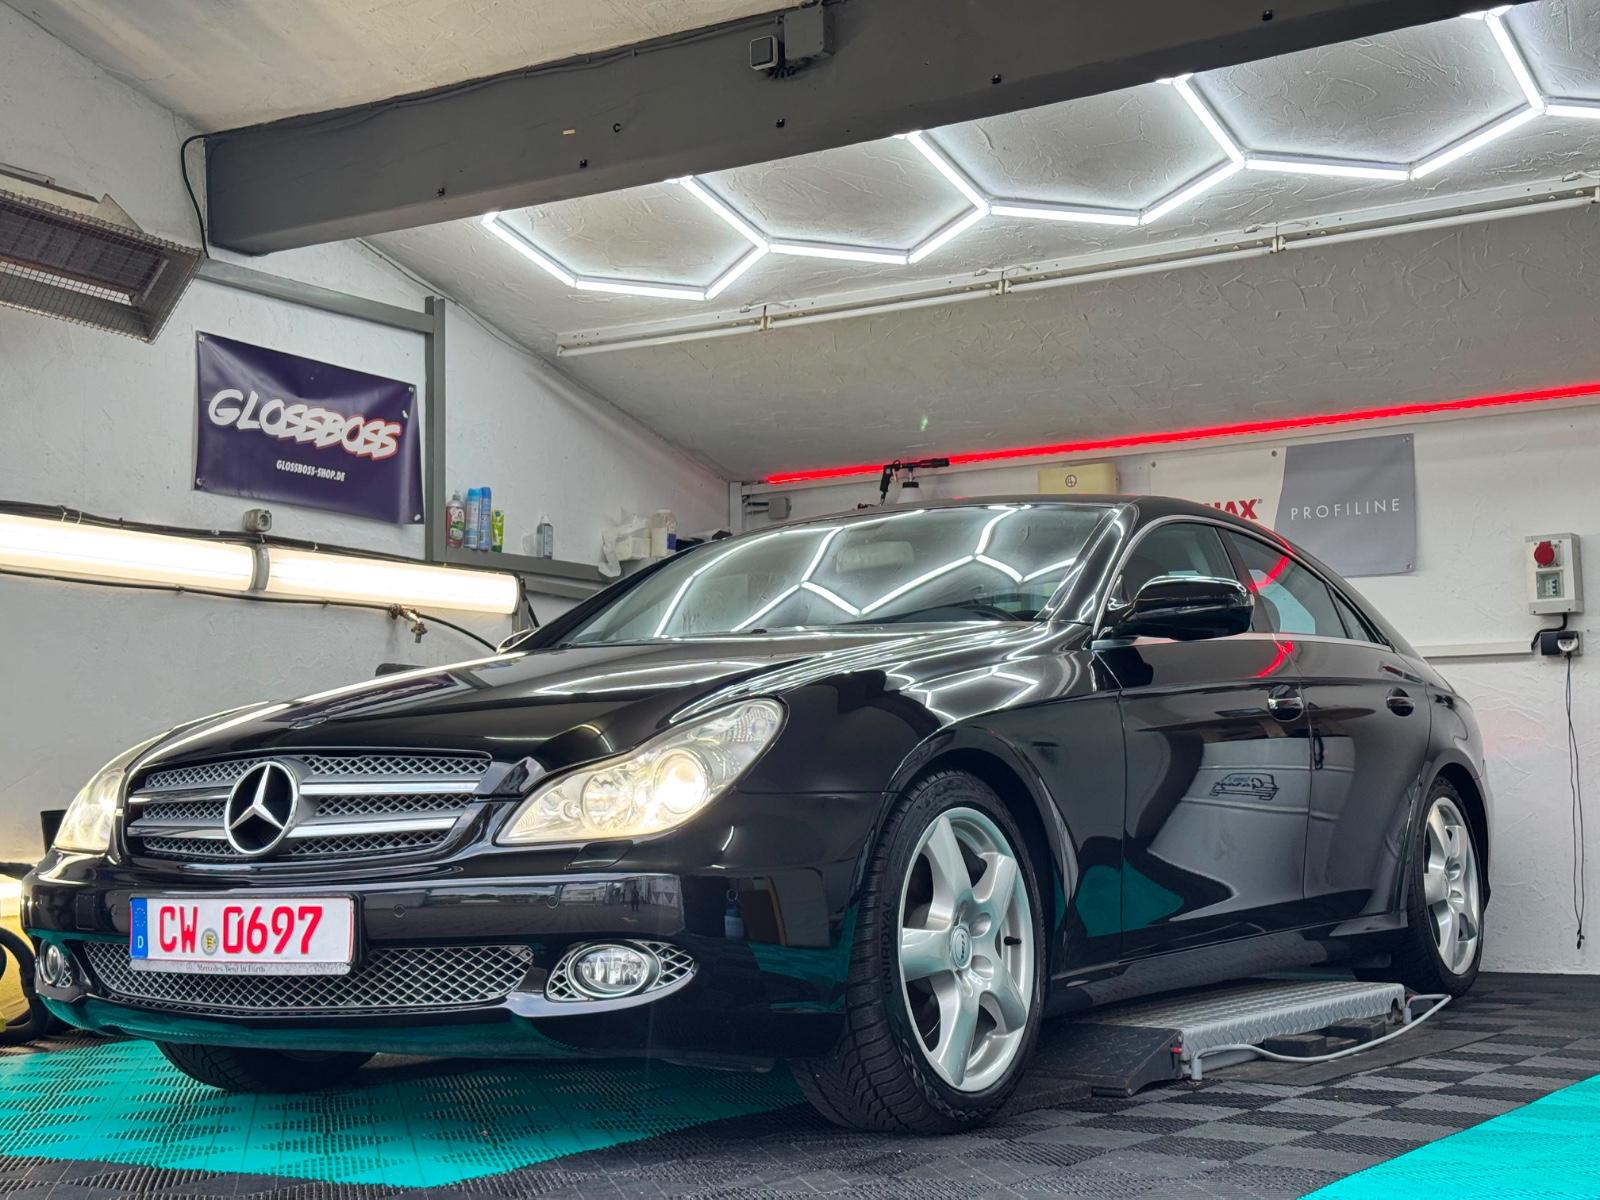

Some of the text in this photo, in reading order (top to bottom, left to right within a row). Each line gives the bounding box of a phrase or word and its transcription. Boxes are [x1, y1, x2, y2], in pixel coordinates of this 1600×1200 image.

[208, 388, 403, 461] GLOSSBOSS
[276, 459, 346, 482] GLOSSBOSS-SHOP.DE
[1290, 498, 1400, 521] PROFILINE
[159, 906, 323, 954] CW 0697
[137, 935, 144, 949] D
